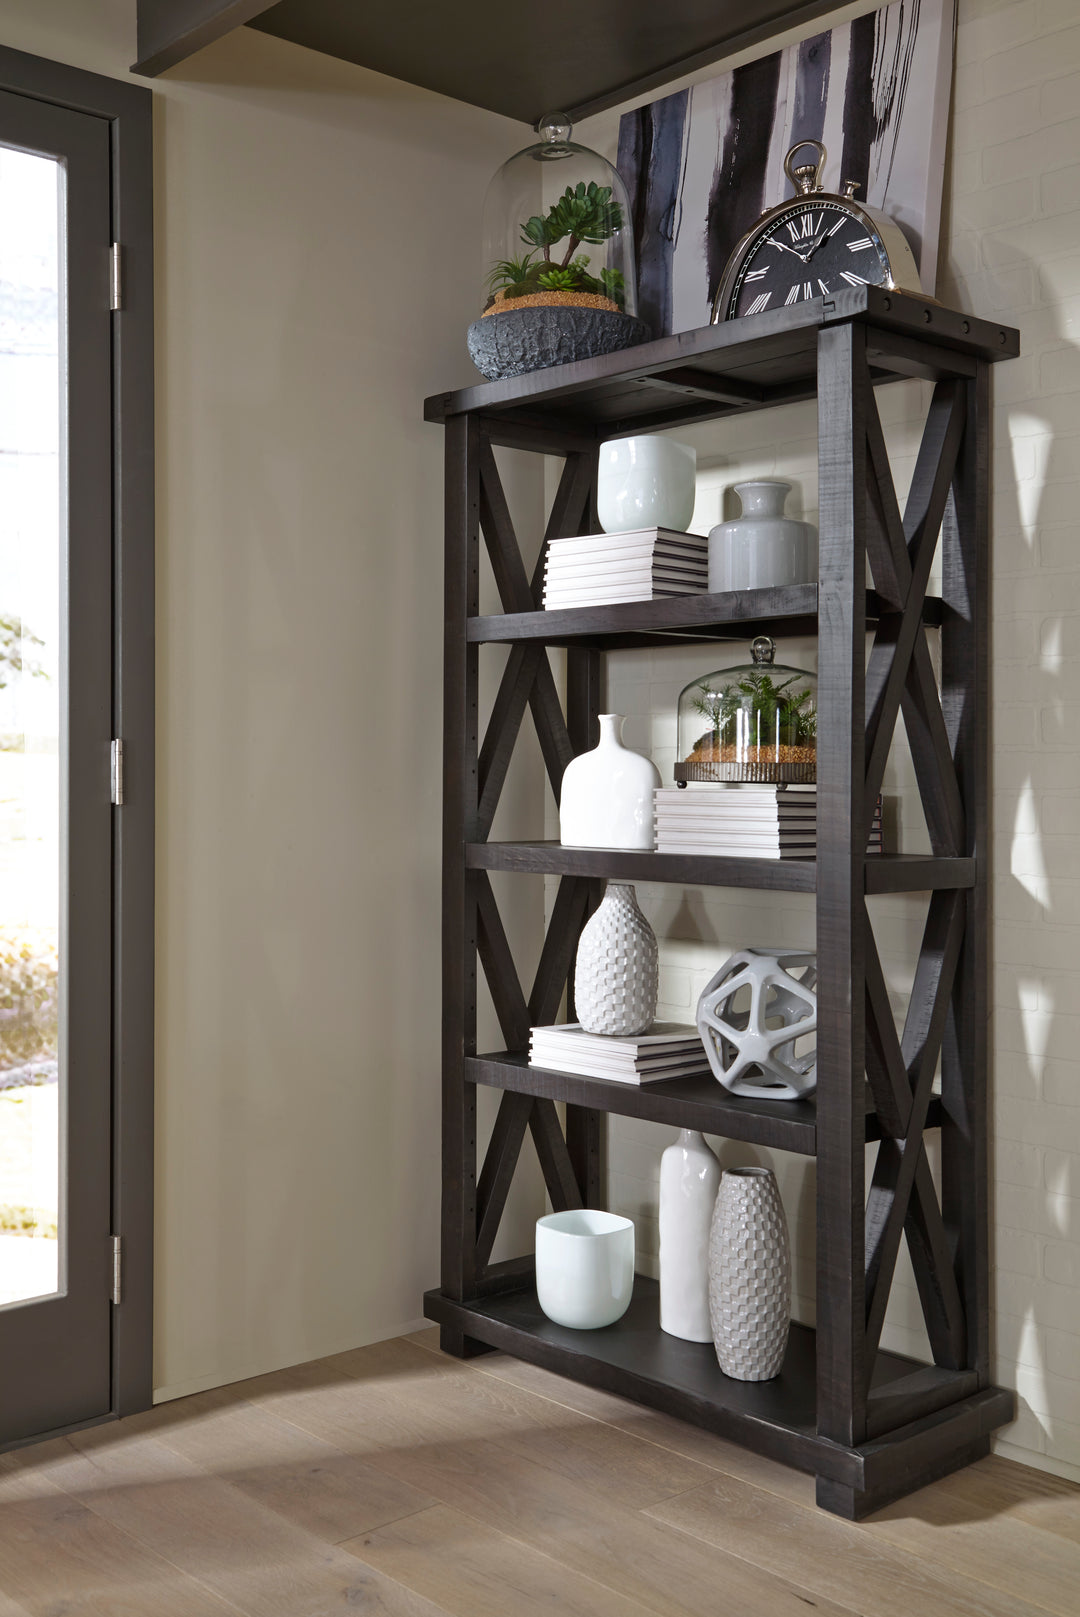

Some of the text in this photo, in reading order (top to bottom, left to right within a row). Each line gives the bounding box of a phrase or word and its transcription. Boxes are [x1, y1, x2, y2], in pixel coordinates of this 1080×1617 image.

[785, 220, 801, 243] XI
[801, 213, 813, 238] XII
[827, 216, 847, 237] II
[846, 237, 873, 252] III
[744, 266, 770, 283] IX
